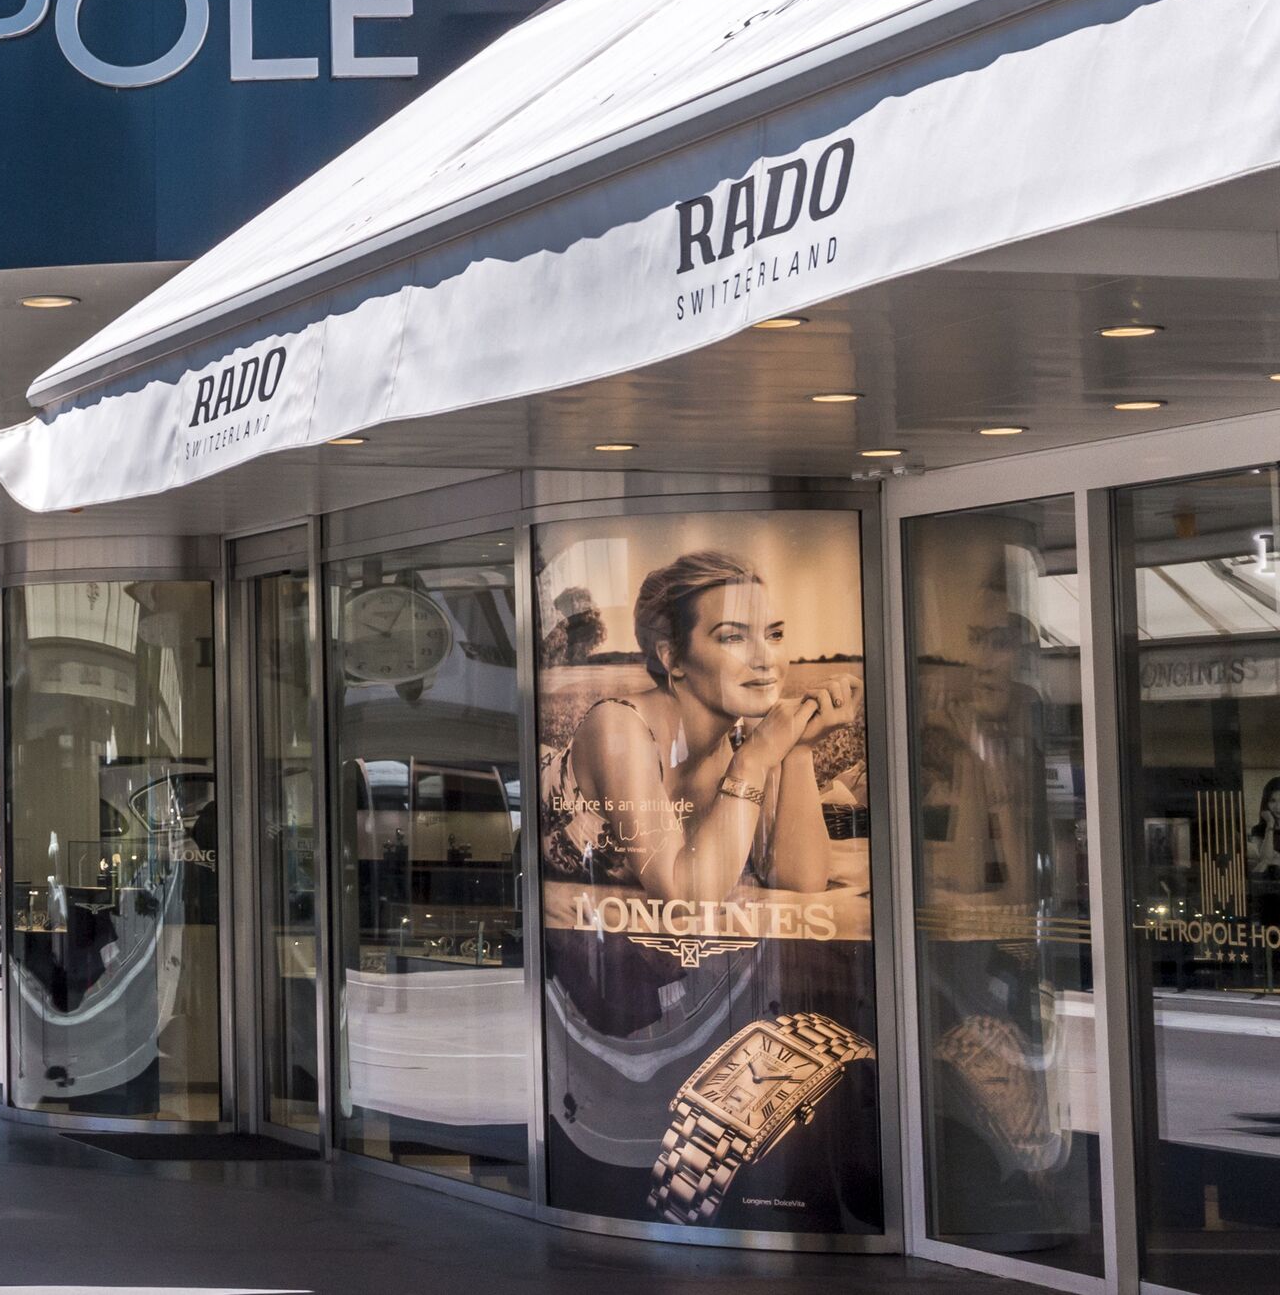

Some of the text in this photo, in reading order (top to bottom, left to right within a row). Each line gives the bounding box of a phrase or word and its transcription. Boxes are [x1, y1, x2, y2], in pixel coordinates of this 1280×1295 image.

[675, 137, 856, 276] RADO
[676, 235, 839, 321] SWITZERLAND
[188, 346, 286, 429] RADO
[185, 414, 269, 460] SWITZERLAND
[553, 797, 694, 813] Elegance is an attitude
[572, 896, 838, 941] LONGINES
[1145, 918, 1248, 947] METROPOLE
[742, 1197, 806, 1207] Longines DolceVita
